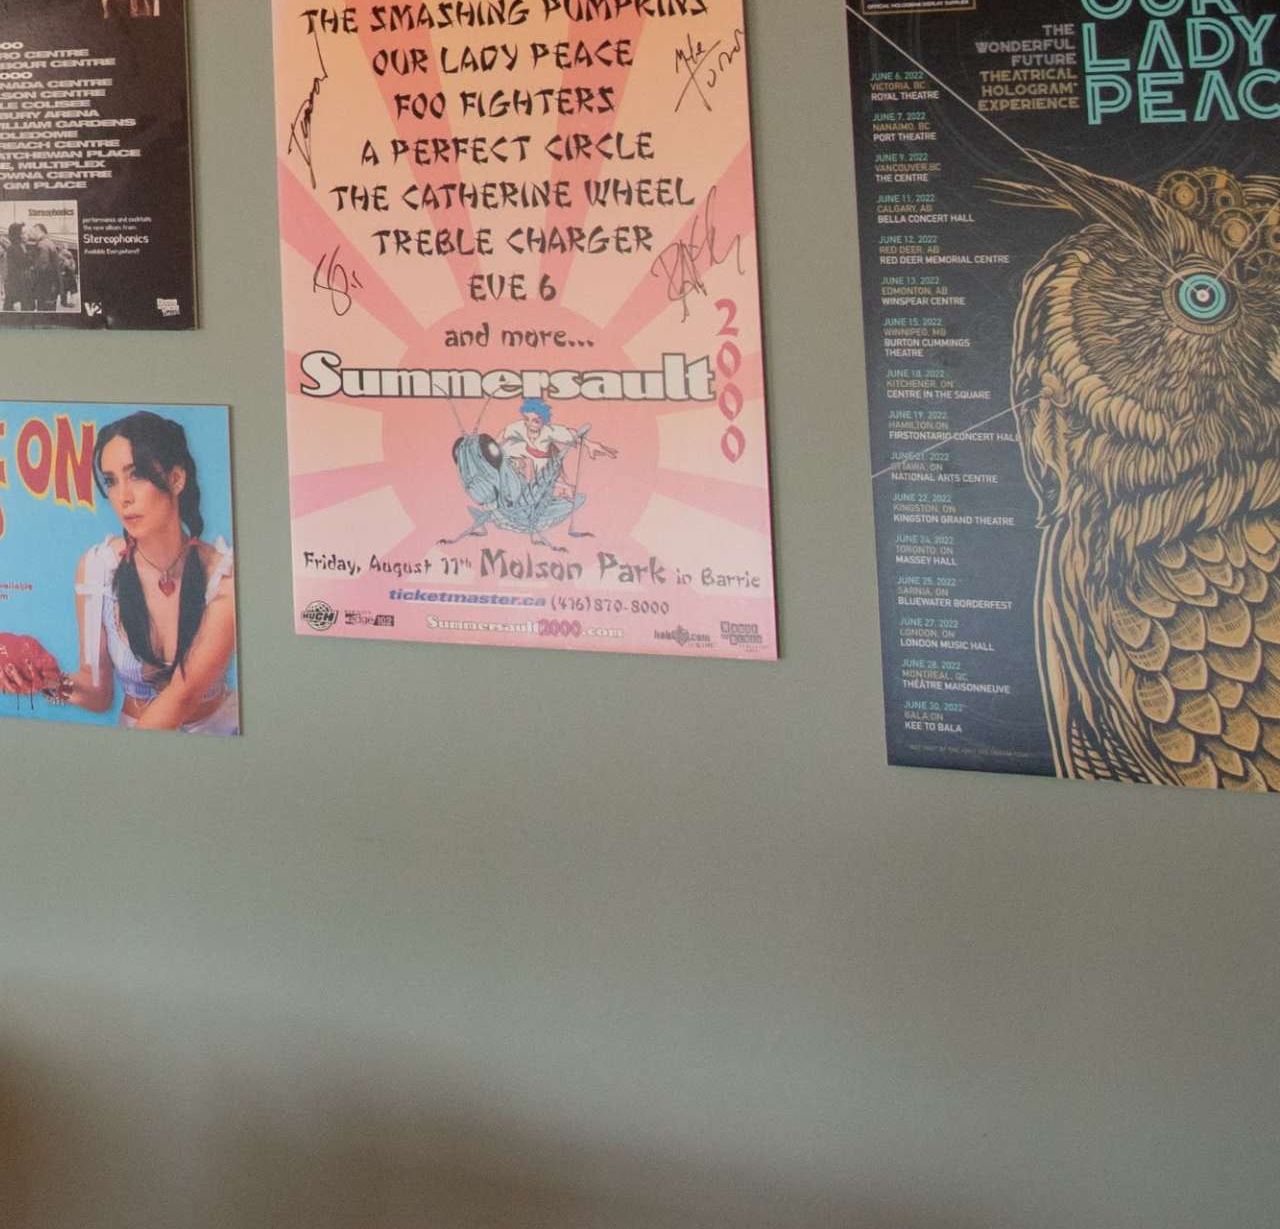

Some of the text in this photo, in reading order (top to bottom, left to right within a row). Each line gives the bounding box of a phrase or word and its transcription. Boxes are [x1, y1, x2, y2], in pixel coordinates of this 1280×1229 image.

[299, 6, 359, 35] THE
[1043, 22, 1075, 37] THE
[371, 39, 636, 77] OUR LADY PEACE
[975, 38, 1076, 54] WONDERFUL
[1011, 53, 1077, 66] FUTURE
[1082, 13, 1276, 74] LADY
[980, 67, 1078, 82] THEATRICAL
[982, 81, 1075, 96] HOLOGRAM
[395, 84, 616, 120] FOO FIGHTERS
[978, 95, 1080, 111] EXPERIENCE
[360, 131, 657, 167] A PERFECT CIRCLE
[330, 176, 697, 214] THE CATHERINE WHEEL
[371, 224, 656, 258] TREBLE CHARGER
[468, 273, 558, 303] EVE 6
[444, 322, 596, 349] and more...
[300, 350, 717, 403] Summersault
[14, 412, 98, 512] ON
[303, 550, 362, 574] Friday,
[369, 553, 433, 576] August
[479, 548, 584, 583] Molson
[598, 550, 668, 586] Park
[676, 567, 693, 586] in
[700, 568, 761, 589] Barrie
